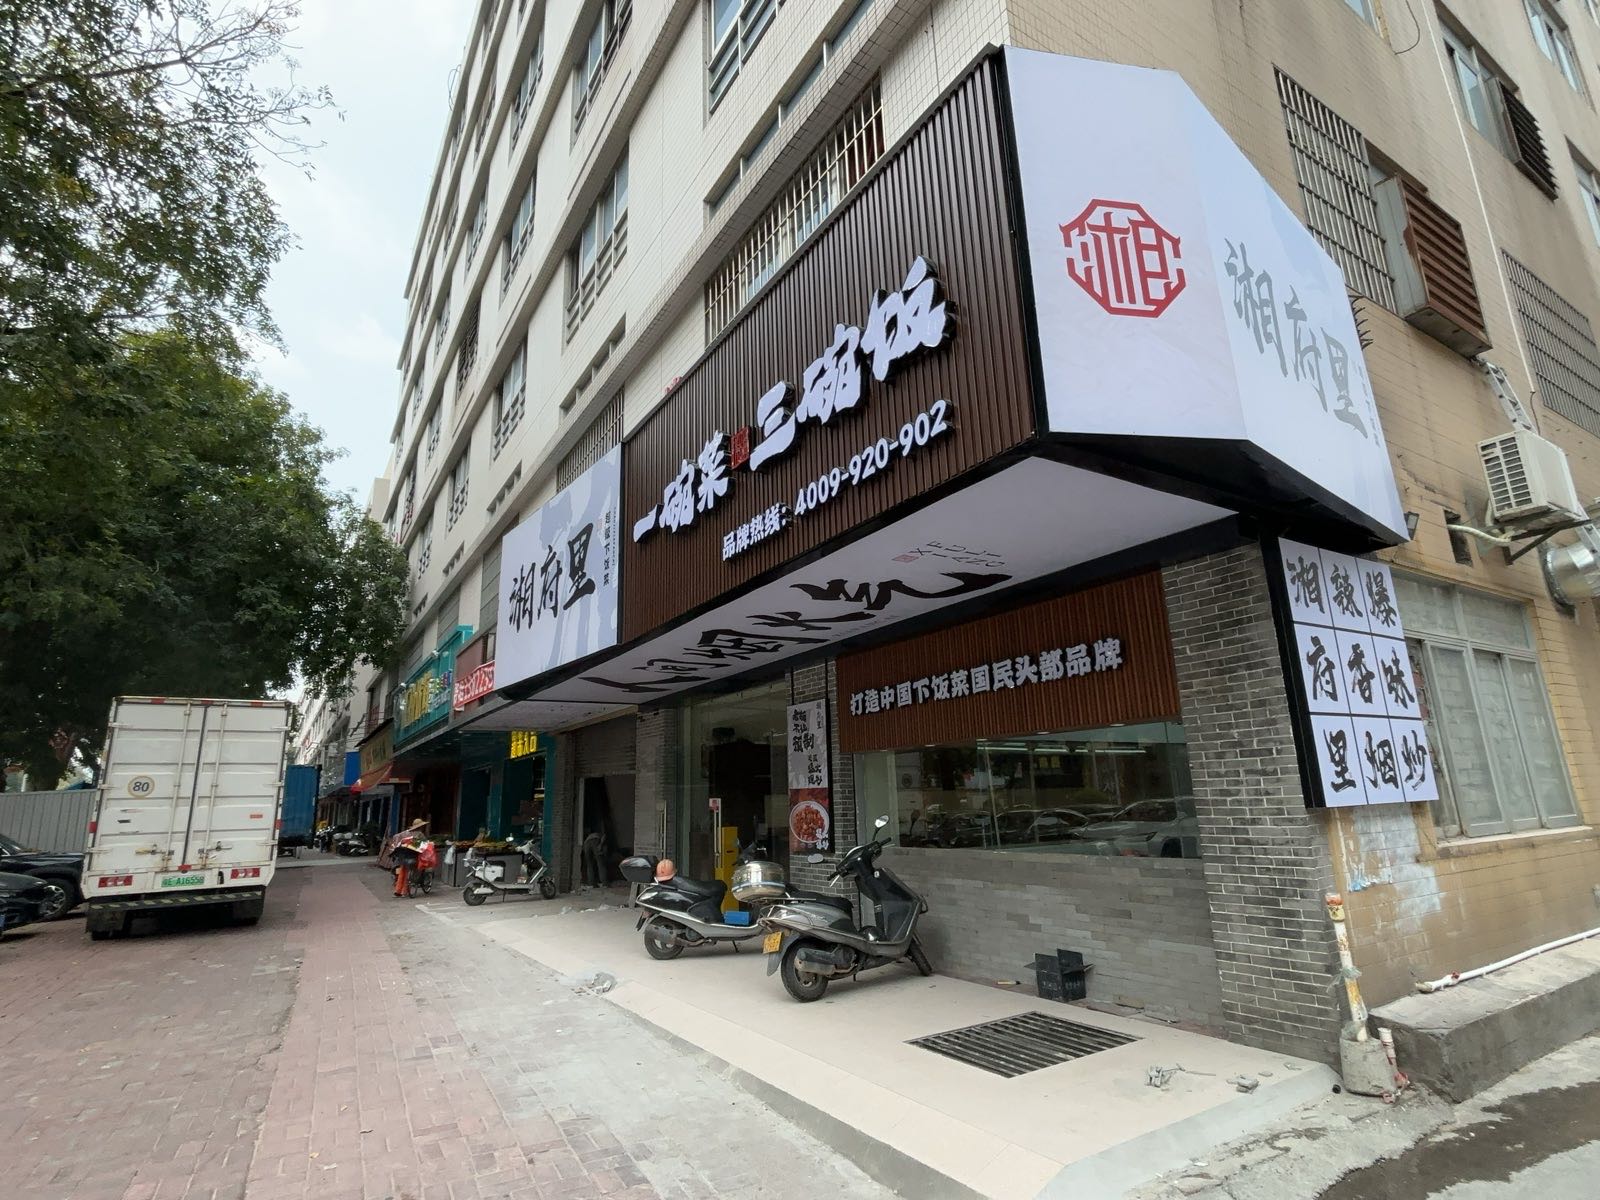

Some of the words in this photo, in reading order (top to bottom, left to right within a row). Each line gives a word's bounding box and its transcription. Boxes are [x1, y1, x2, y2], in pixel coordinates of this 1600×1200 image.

[1223, 237, 1369, 439] 湘府里
[794, 399, 948, 517] 4009-920-902
[509, 522, 596, 633] 湘府里
[578, 571, 1013, 693] 人间烟火气
[850, 637, 1122, 716] 打造中国下饭菜国民头部品牌
[132, 781, 150, 792] 80
